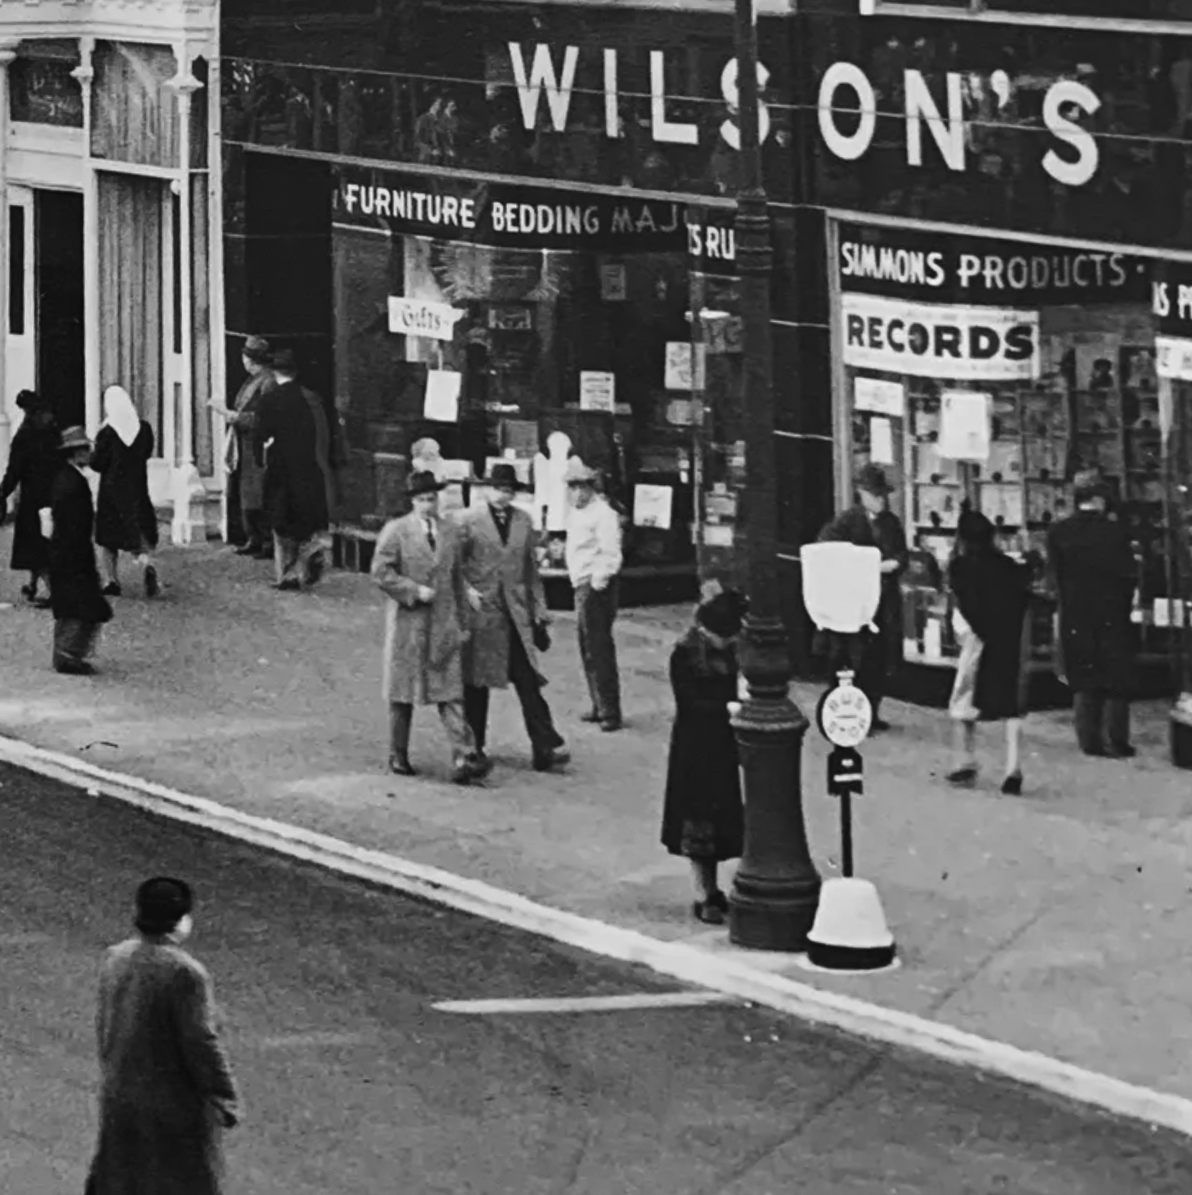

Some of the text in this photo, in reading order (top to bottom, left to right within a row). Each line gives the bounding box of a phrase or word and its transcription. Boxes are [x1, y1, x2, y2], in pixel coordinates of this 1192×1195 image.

[346, 184, 476, 229] FURNITURE
[491, 202, 599, 235] BEDDING
[841, 241, 1127, 289] SIMMONS PRODUCTS
[846, 313, 1034, 362] RECORDS
